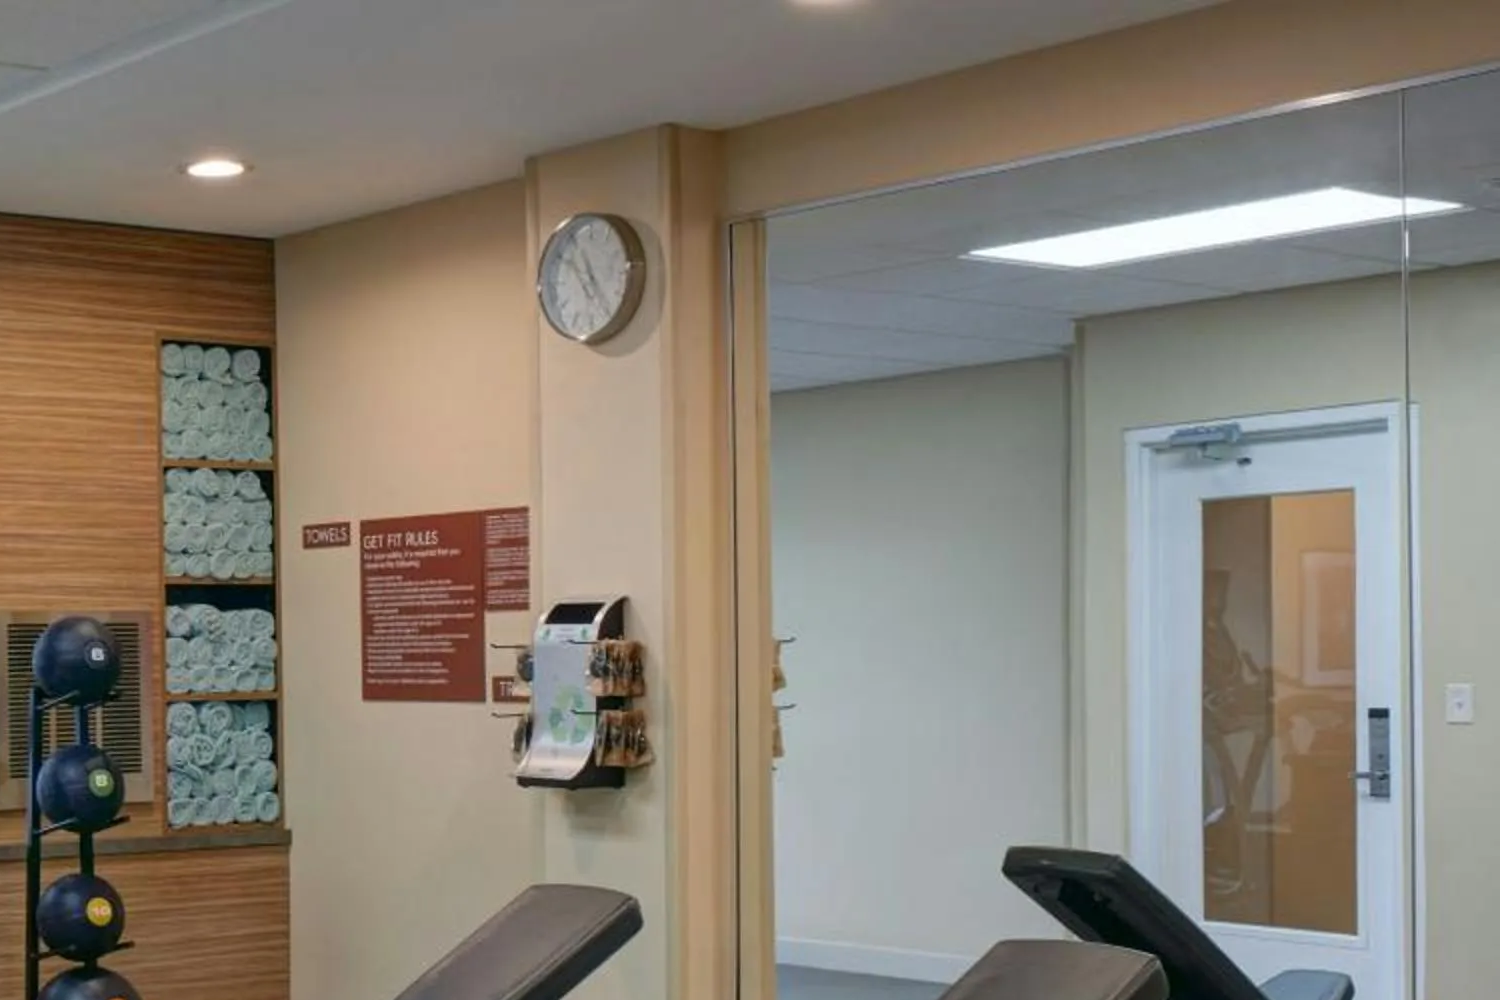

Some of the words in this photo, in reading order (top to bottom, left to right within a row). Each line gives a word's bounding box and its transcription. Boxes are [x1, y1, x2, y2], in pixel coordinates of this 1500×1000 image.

[306, 527, 348, 544] TOWELS
[363, 535, 383, 549] GET
[387, 533, 402, 548] FIT
[405, 530, 439, 546] RULES
